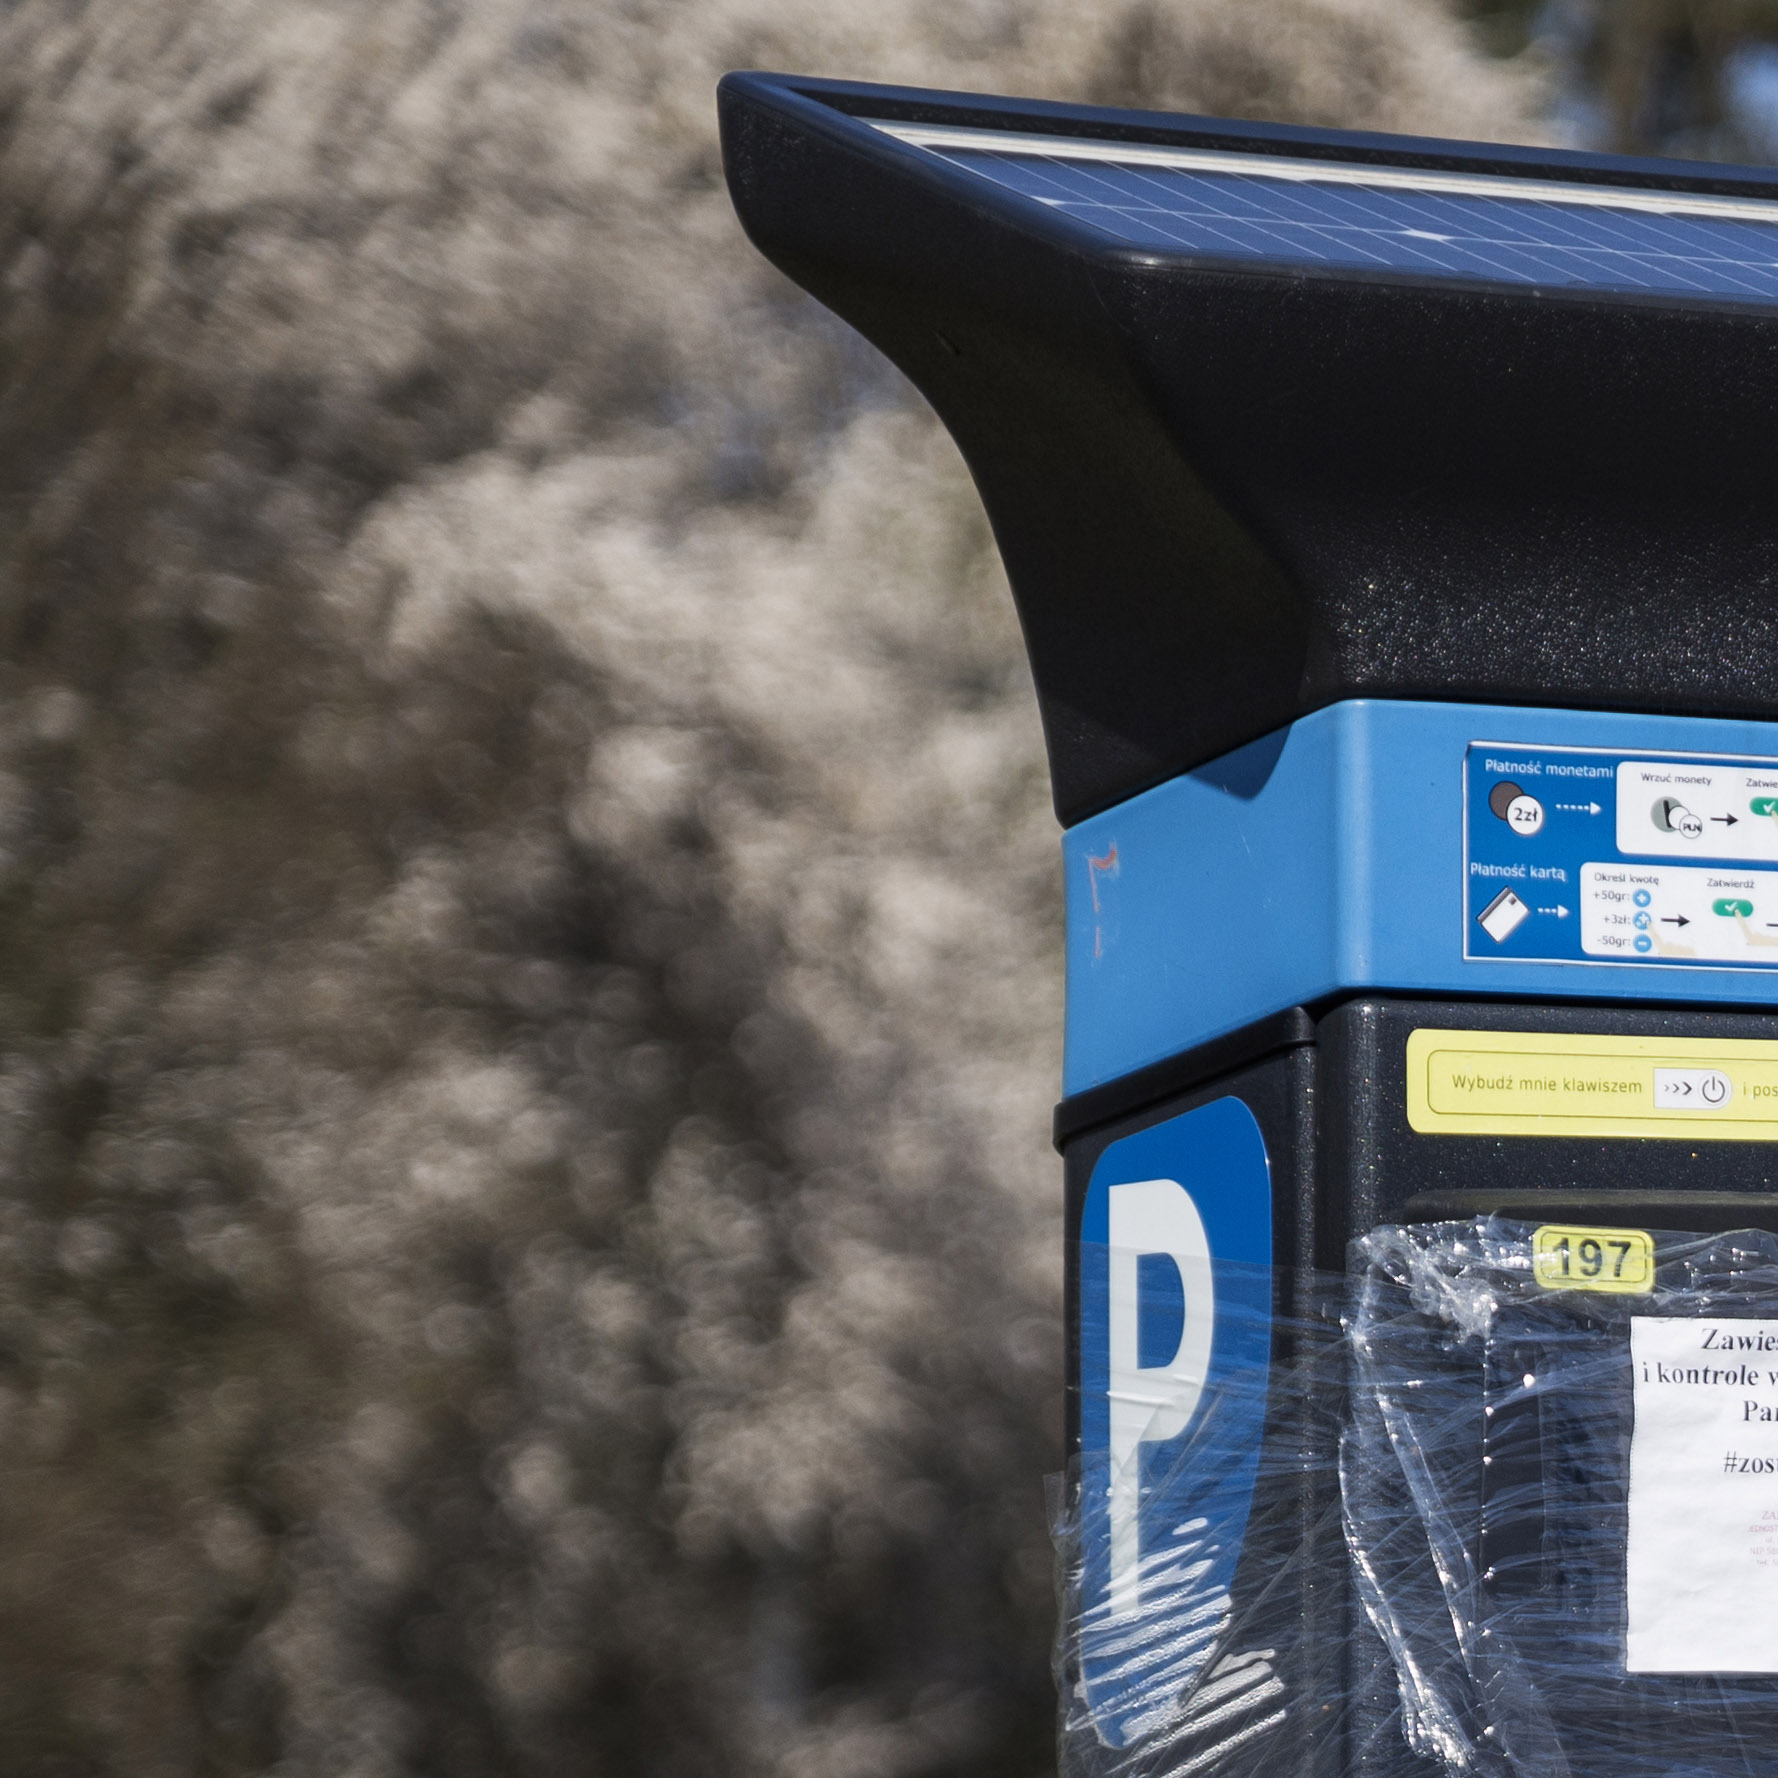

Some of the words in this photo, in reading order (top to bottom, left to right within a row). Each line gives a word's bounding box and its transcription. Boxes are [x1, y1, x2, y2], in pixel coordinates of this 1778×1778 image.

[1485, 758, 1541, 775] Płatność
[1546, 764, 1614, 779] monetami
[1641, 772, 1671, 783] Wrzuć
[1674, 775, 1712, 786] monety
[1514, 807, 1538, 822] 2zł
[1470, 862, 1526, 877] Płatność
[1530, 865, 1566, 882] kartą
[1594, 872, 1626, 883] Określ
[1629, 874, 1660, 886] kwotę
[1707, 878, 1755, 889] Zatwierdź
[1452, 1074, 1513, 1093] Wybudź
[1520, 1078, 1557, 1092] mnie
[1563, 1077, 1642, 1094] klawiszem
[1743, 1082, 1747, 1097] i
[1553, 1236, 1633, 1279] 197
[1643, 1362, 1649, 1383] i
[1656, 1362, 1760, 1387] kontrole
[1108, 1178, 1214, 1615] P
